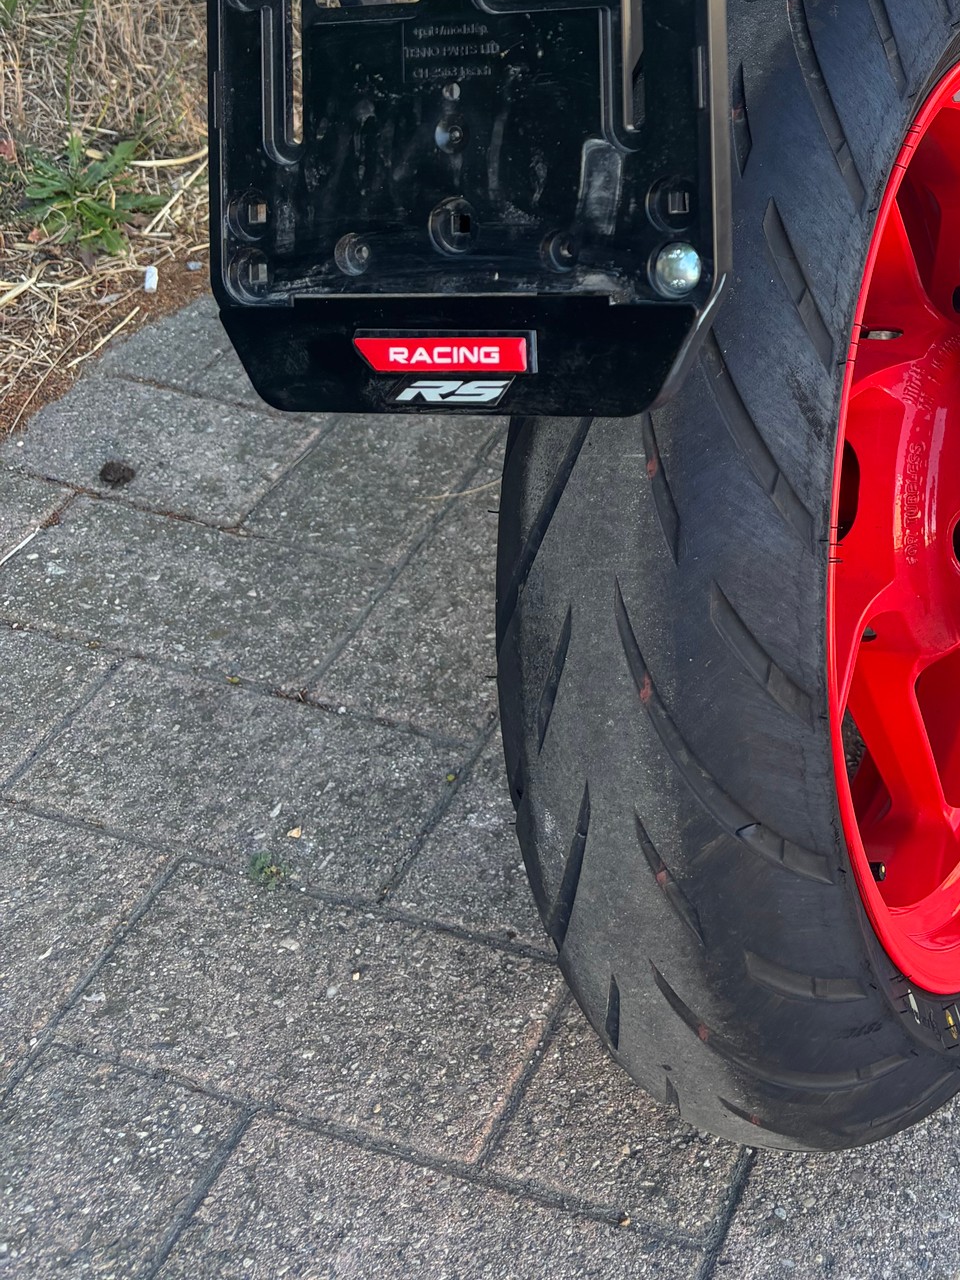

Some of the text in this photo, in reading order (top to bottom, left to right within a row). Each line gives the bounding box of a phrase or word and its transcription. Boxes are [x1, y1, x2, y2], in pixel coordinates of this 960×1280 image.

[388, 346, 500, 364] RACING
[395, 380, 511, 402] RS
[903, 440, 927, 526] TUBELESS
